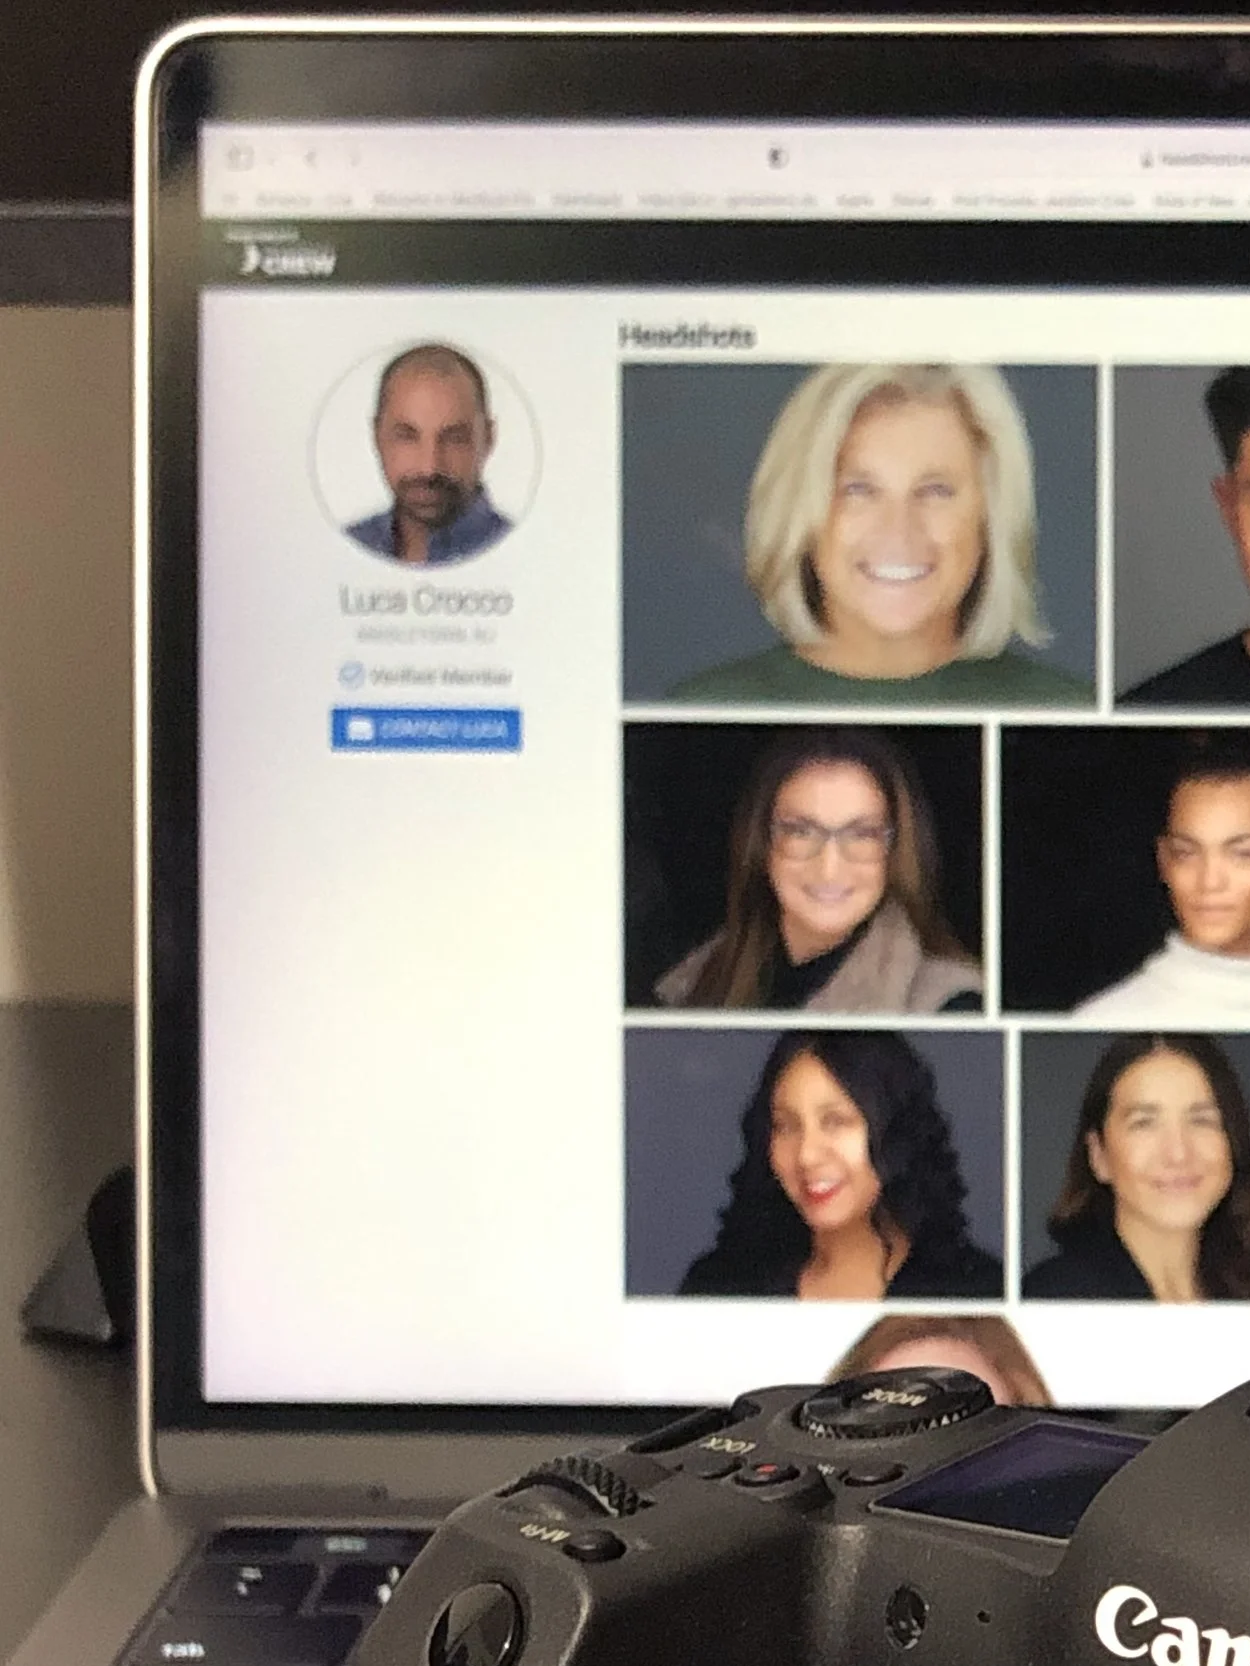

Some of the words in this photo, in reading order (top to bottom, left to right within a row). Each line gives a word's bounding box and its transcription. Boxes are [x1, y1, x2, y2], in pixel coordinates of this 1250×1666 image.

[618, 322, 757, 349] Headshots
[338, 583, 408, 616] Luca
[413, 583, 514, 616] Crocco
[161, 1641, 206, 1659] tab
